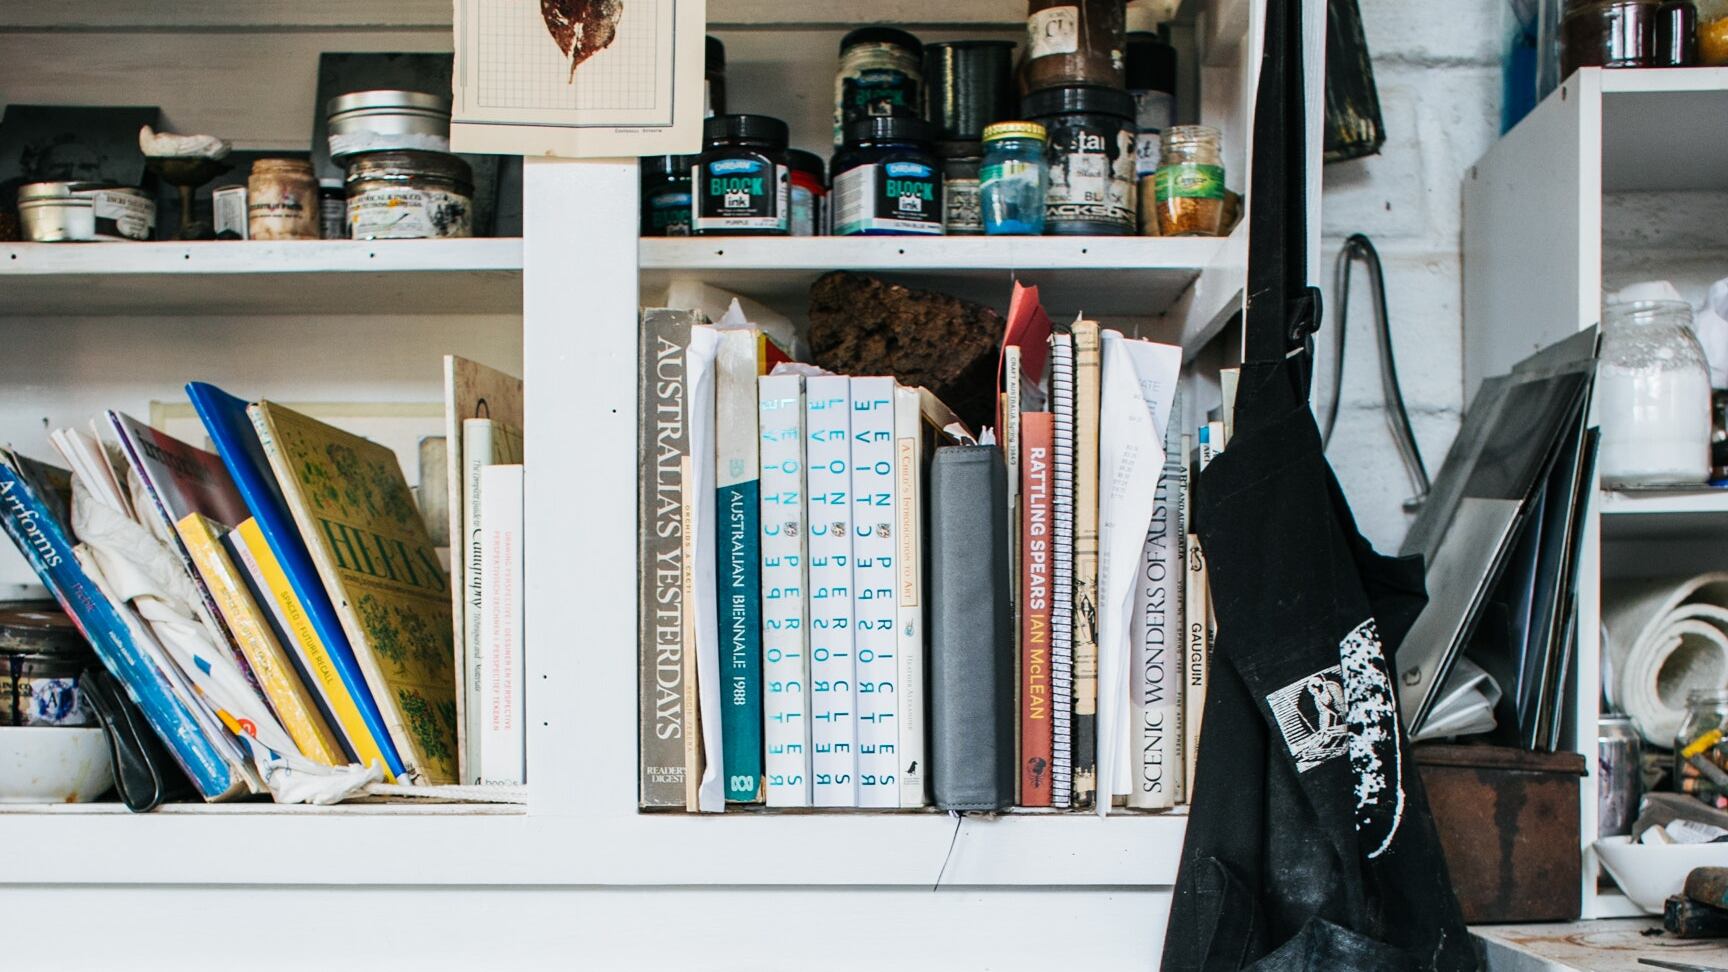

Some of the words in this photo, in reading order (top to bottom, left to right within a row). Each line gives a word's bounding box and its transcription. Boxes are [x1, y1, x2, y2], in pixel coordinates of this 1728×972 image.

[710, 177, 763, 196] BLOCK
[728, 197, 746, 206] ink
[886, 180, 934, 200] BLOCK
[656, 335, 682, 539] AUSTRALIA'S
[829, 398, 846, 505] LEON
[874, 399, 892, 507] LEON
[1030, 447, 1047, 537] RATTLING
[1178, 492, 1187, 512] AND
[1179, 466, 1189, 491] ART
[0, 479, 64, 568] Artforms
[730, 490, 746, 588] AUSTRALIAN
[1177, 513, 1186, 560] AUSTRALIA
[1030, 540, 1046, 610] SPEARS
[1146, 549, 1167, 583] OF
[300, 626, 318, 656] FUTURE
[316, 655, 334, 685] RECALL
[656, 545, 682, 741] YESTERDAYS
[731, 594, 746, 669] BIENNALE
[1030, 614, 1045, 644] IAN
[1144, 586, 1166, 706] WONDERS
[1191, 622, 1202, 687] GAUGUIN
[733, 676, 746, 706] 1988
[784, 555, 803, 786] PERICLES
[832, 555, 851, 785] PERICLES
[876, 556, 896, 786] PERICLES
[1029, 649, 1045, 720] McLEAN
[651, 775, 684, 783] DIGEST
[1143, 711, 1165, 794] SCENIC
